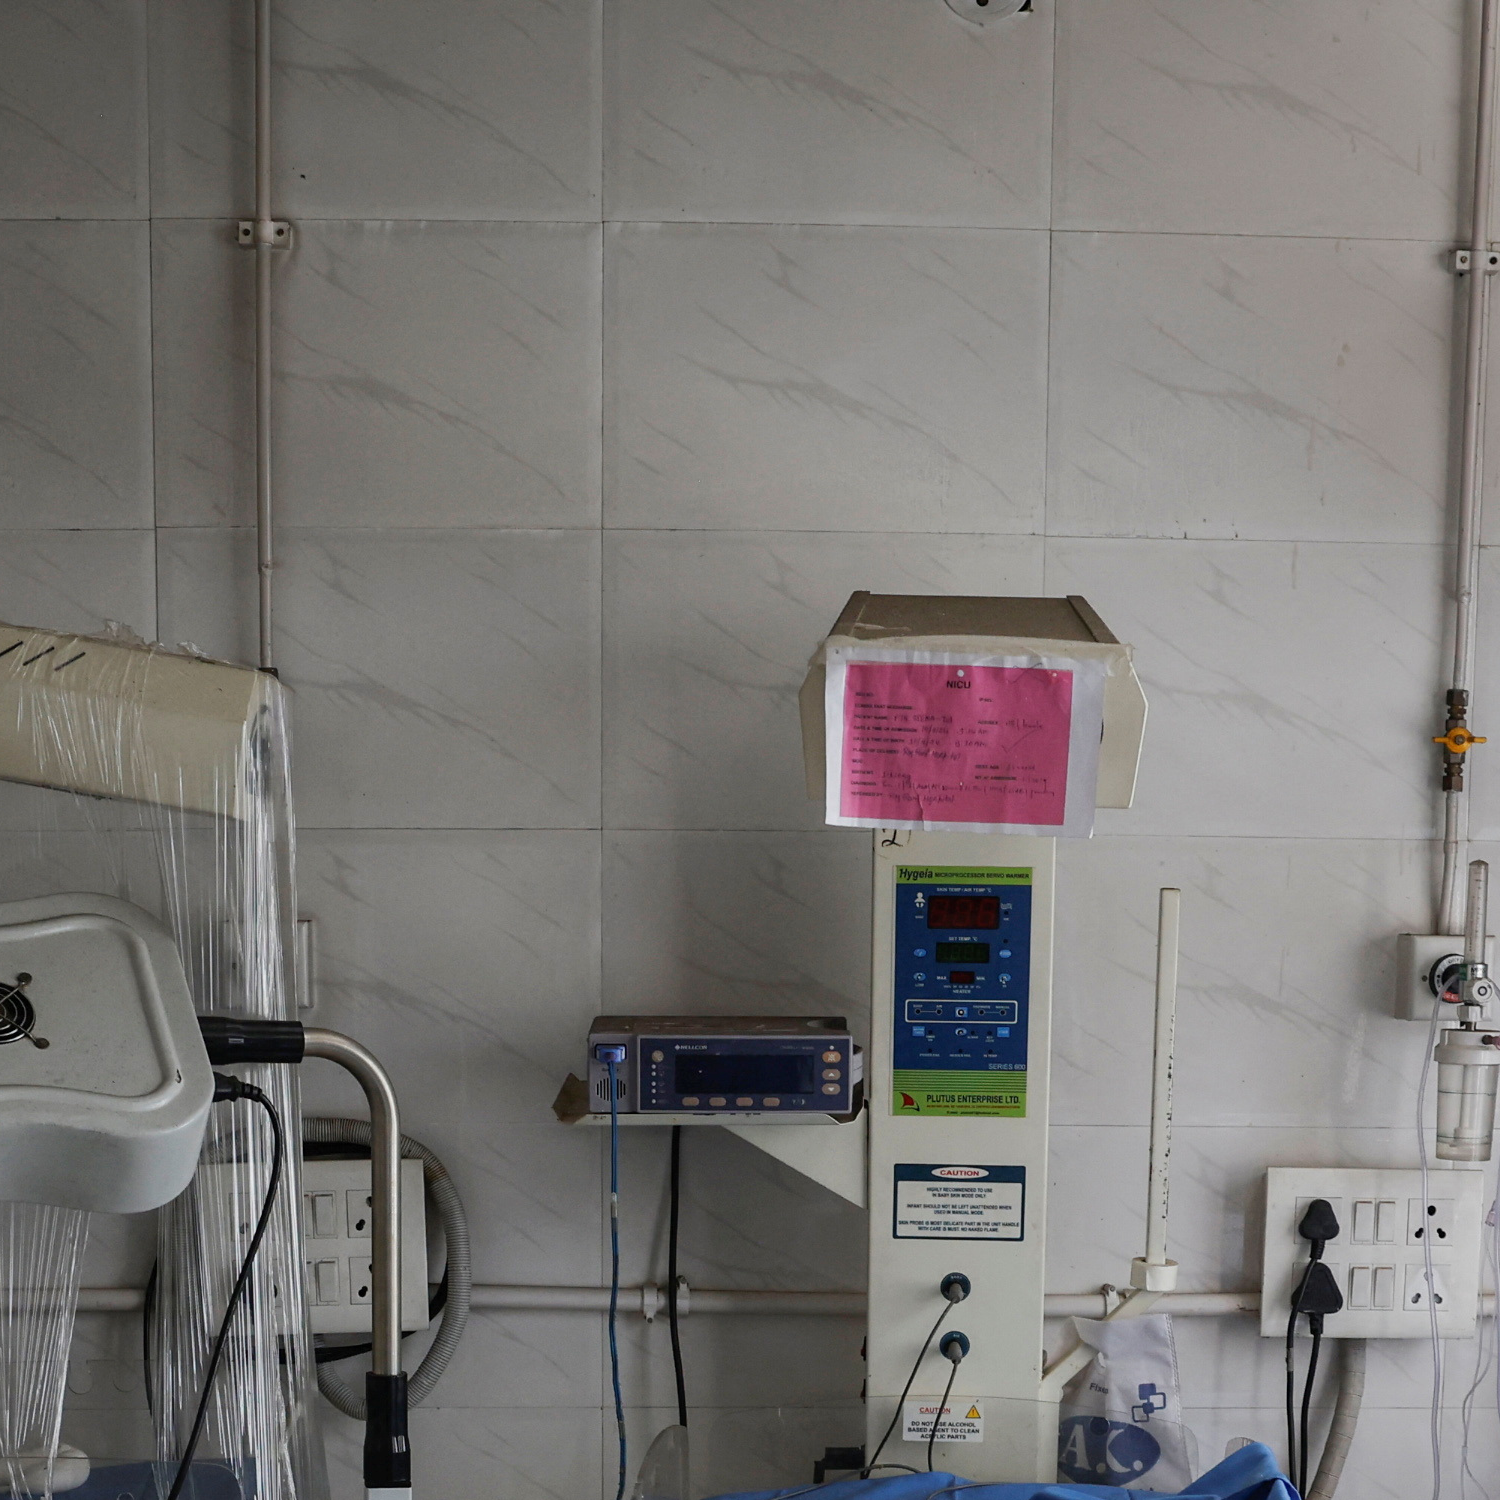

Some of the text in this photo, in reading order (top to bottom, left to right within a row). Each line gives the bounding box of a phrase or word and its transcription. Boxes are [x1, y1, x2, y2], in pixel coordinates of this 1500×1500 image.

[946, 680, 971, 689] NICU
[899, 868, 933, 881] Hygeia
[926, 1094, 1021, 1104] PLUTUS ENTERPRISE LTD.
